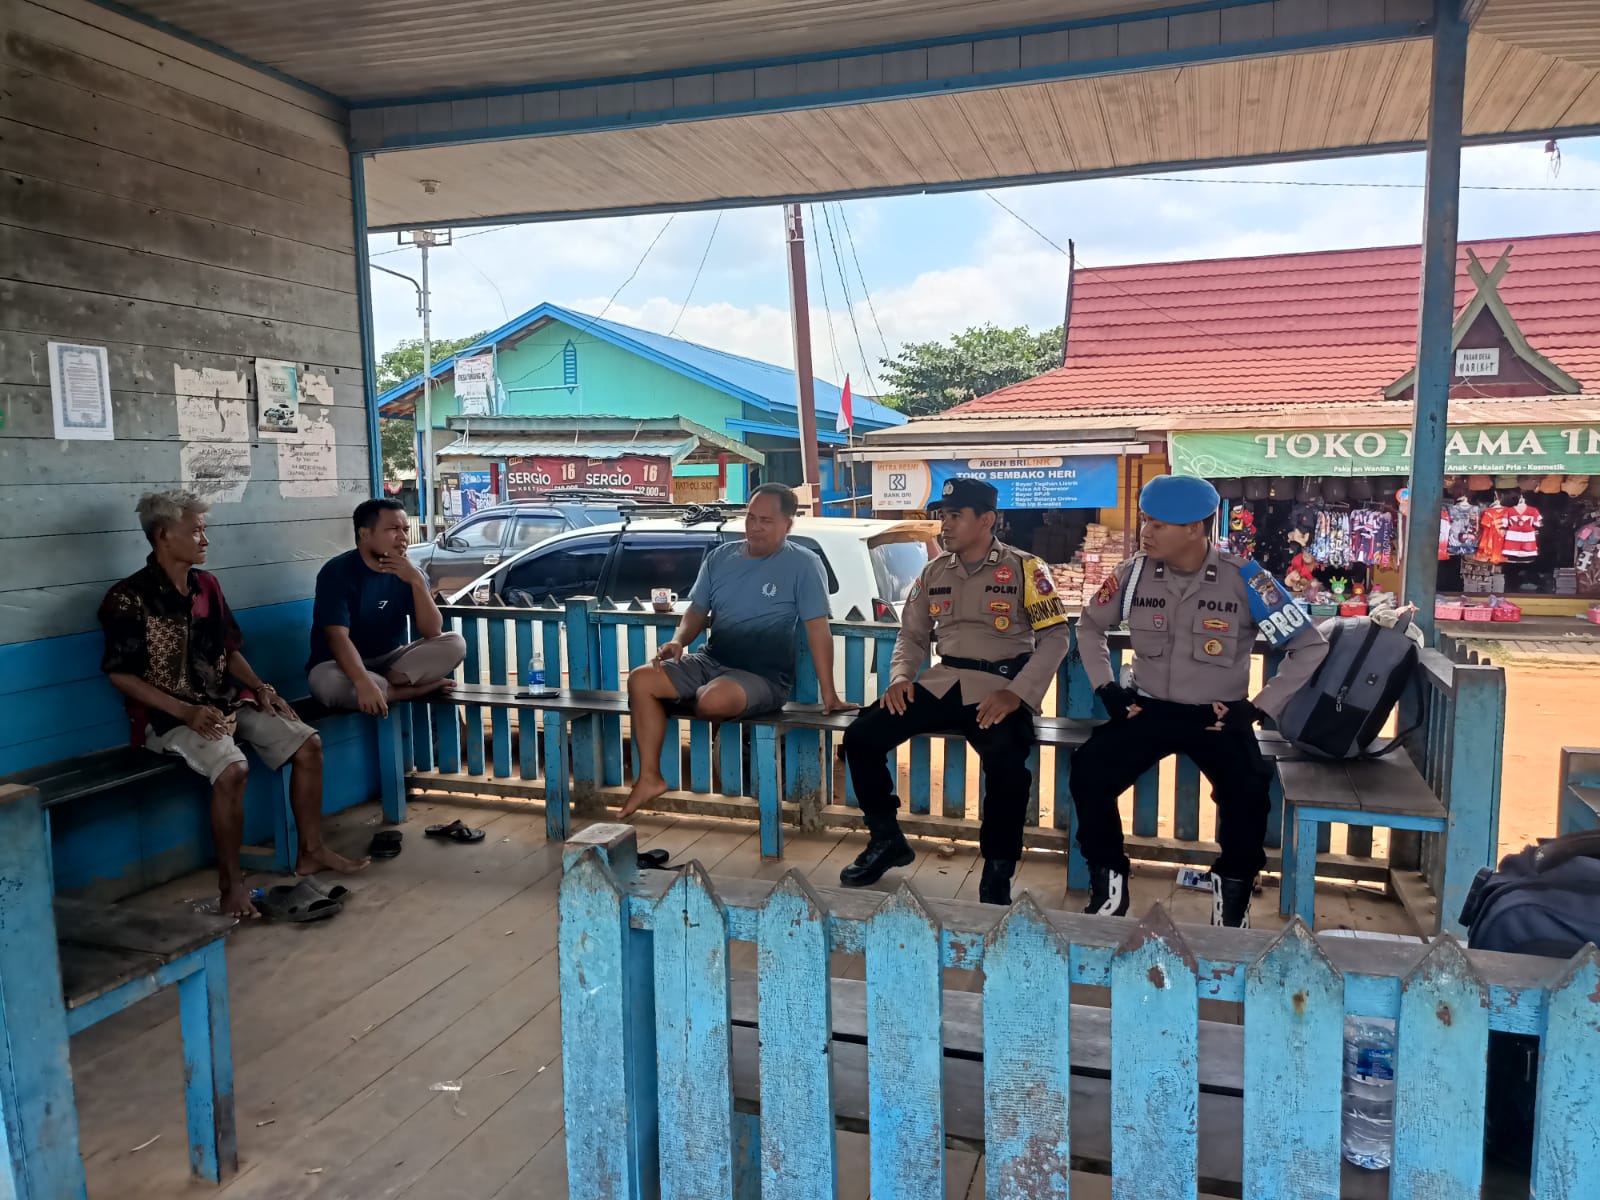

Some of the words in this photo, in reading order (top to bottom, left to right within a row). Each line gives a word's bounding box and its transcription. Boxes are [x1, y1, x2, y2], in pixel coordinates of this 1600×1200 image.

[1254, 431, 1387, 458] TOKO
[980, 460, 1006, 468] AGEN
[1473, 463, 1505, 471] Pakaian
[1506, 463, 1522, 471] Pria
[1527, 462, 1566, 471] Kosmetik
[561, 463, 576, 480] 16
[643, 464, 658, 482] 16
[956, 472, 986, 481] TOKO
[990, 470, 1044, 480] SEMBAKO
[1048, 470, 1076, 478] HERI
[508, 472, 550, 485] SERGIO
[586, 474, 632, 486] SERGIO
[985, 586, 1018, 594] POLRI
[1198, 600, 1238, 613] POLRI
